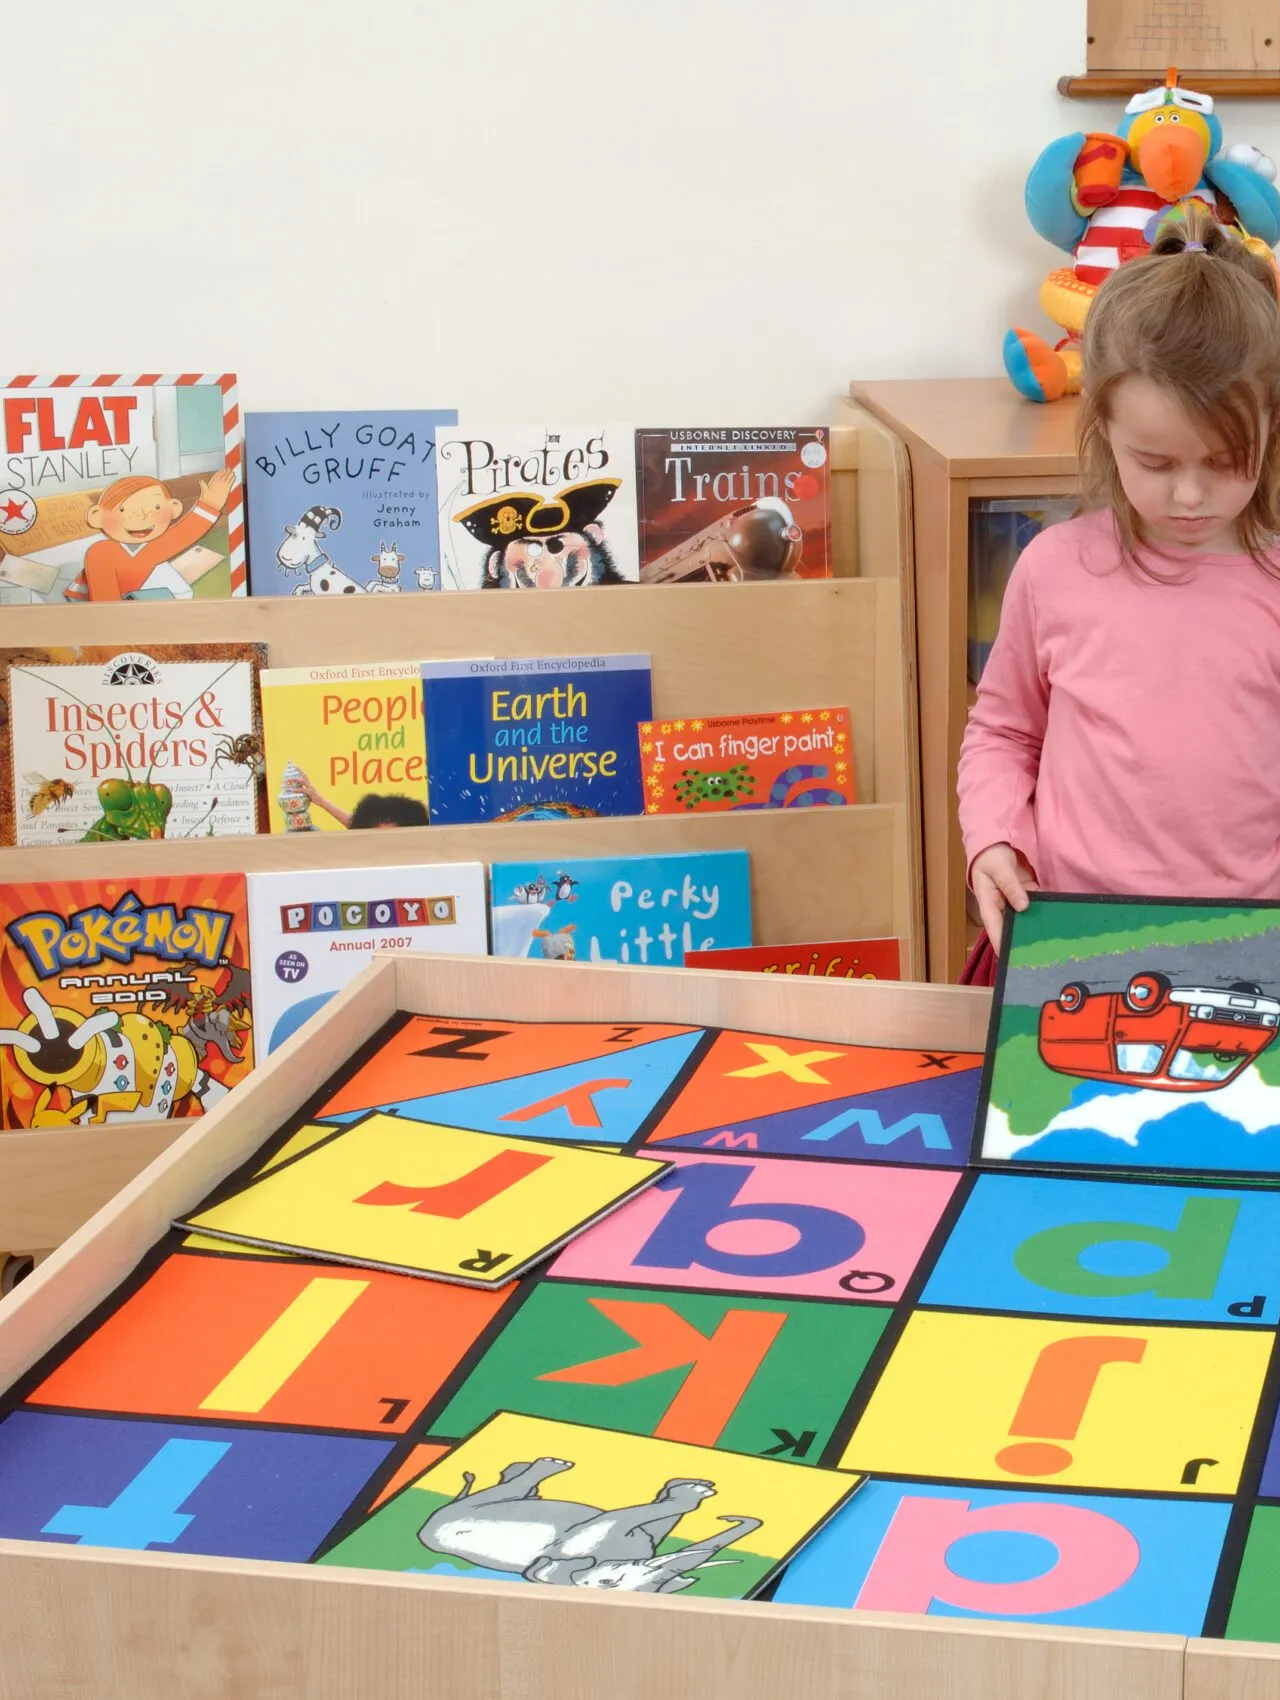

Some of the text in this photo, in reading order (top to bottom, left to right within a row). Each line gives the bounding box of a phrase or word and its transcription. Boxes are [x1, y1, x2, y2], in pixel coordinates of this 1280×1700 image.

[4, 396, 137, 454] FLAT
[670, 430, 797, 440] USBORNE DISCOVERY
[255, 423, 435, 477] BILLY GOAT
[440, 430, 609, 496] Pirates
[7, 447, 138, 490] STANLEY
[303, 457, 406, 484] GRUFF
[665, 457, 802, 502] Trains
[362, 490, 430, 501] illustrated by
[373, 518, 421, 528] Graham
[377, 504, 416, 516] Jenny
[101, 655, 163, 686] DISCOVERIES
[310, 665, 420, 681] Oxford First Encyclo
[470, 658, 606, 673] Oxford First Encyclopedia
[45, 691, 224, 732] Insects &
[322, 686, 424, 731] Peopl
[492, 683, 587, 721] Earth
[495, 721, 588, 746] and the
[707, 716, 776, 728] Usborne Playtime
[357, 725, 405, 751] and
[655, 726, 835, 762] I can finger paint
[64, 732, 208, 777] Spiders
[469, 746, 617, 784] Universe
[330, 750, 426, 786] Place
[610, 873, 719, 919] Perky
[283, 899, 453, 930] POCOYO
[330, 937, 413, 952] Annual 2007
[279, 959, 296, 967] SEEN
[283, 968, 300, 979] TV
[60, 972, 196, 989] ANNUAL
[91, 990, 167, 1004] 2010
[458, 1249, 514, 1273] R
[839, 1269, 895, 1294] Q
[378, 1398, 411, 1424] L
[759, 1428, 817, 1458] K
